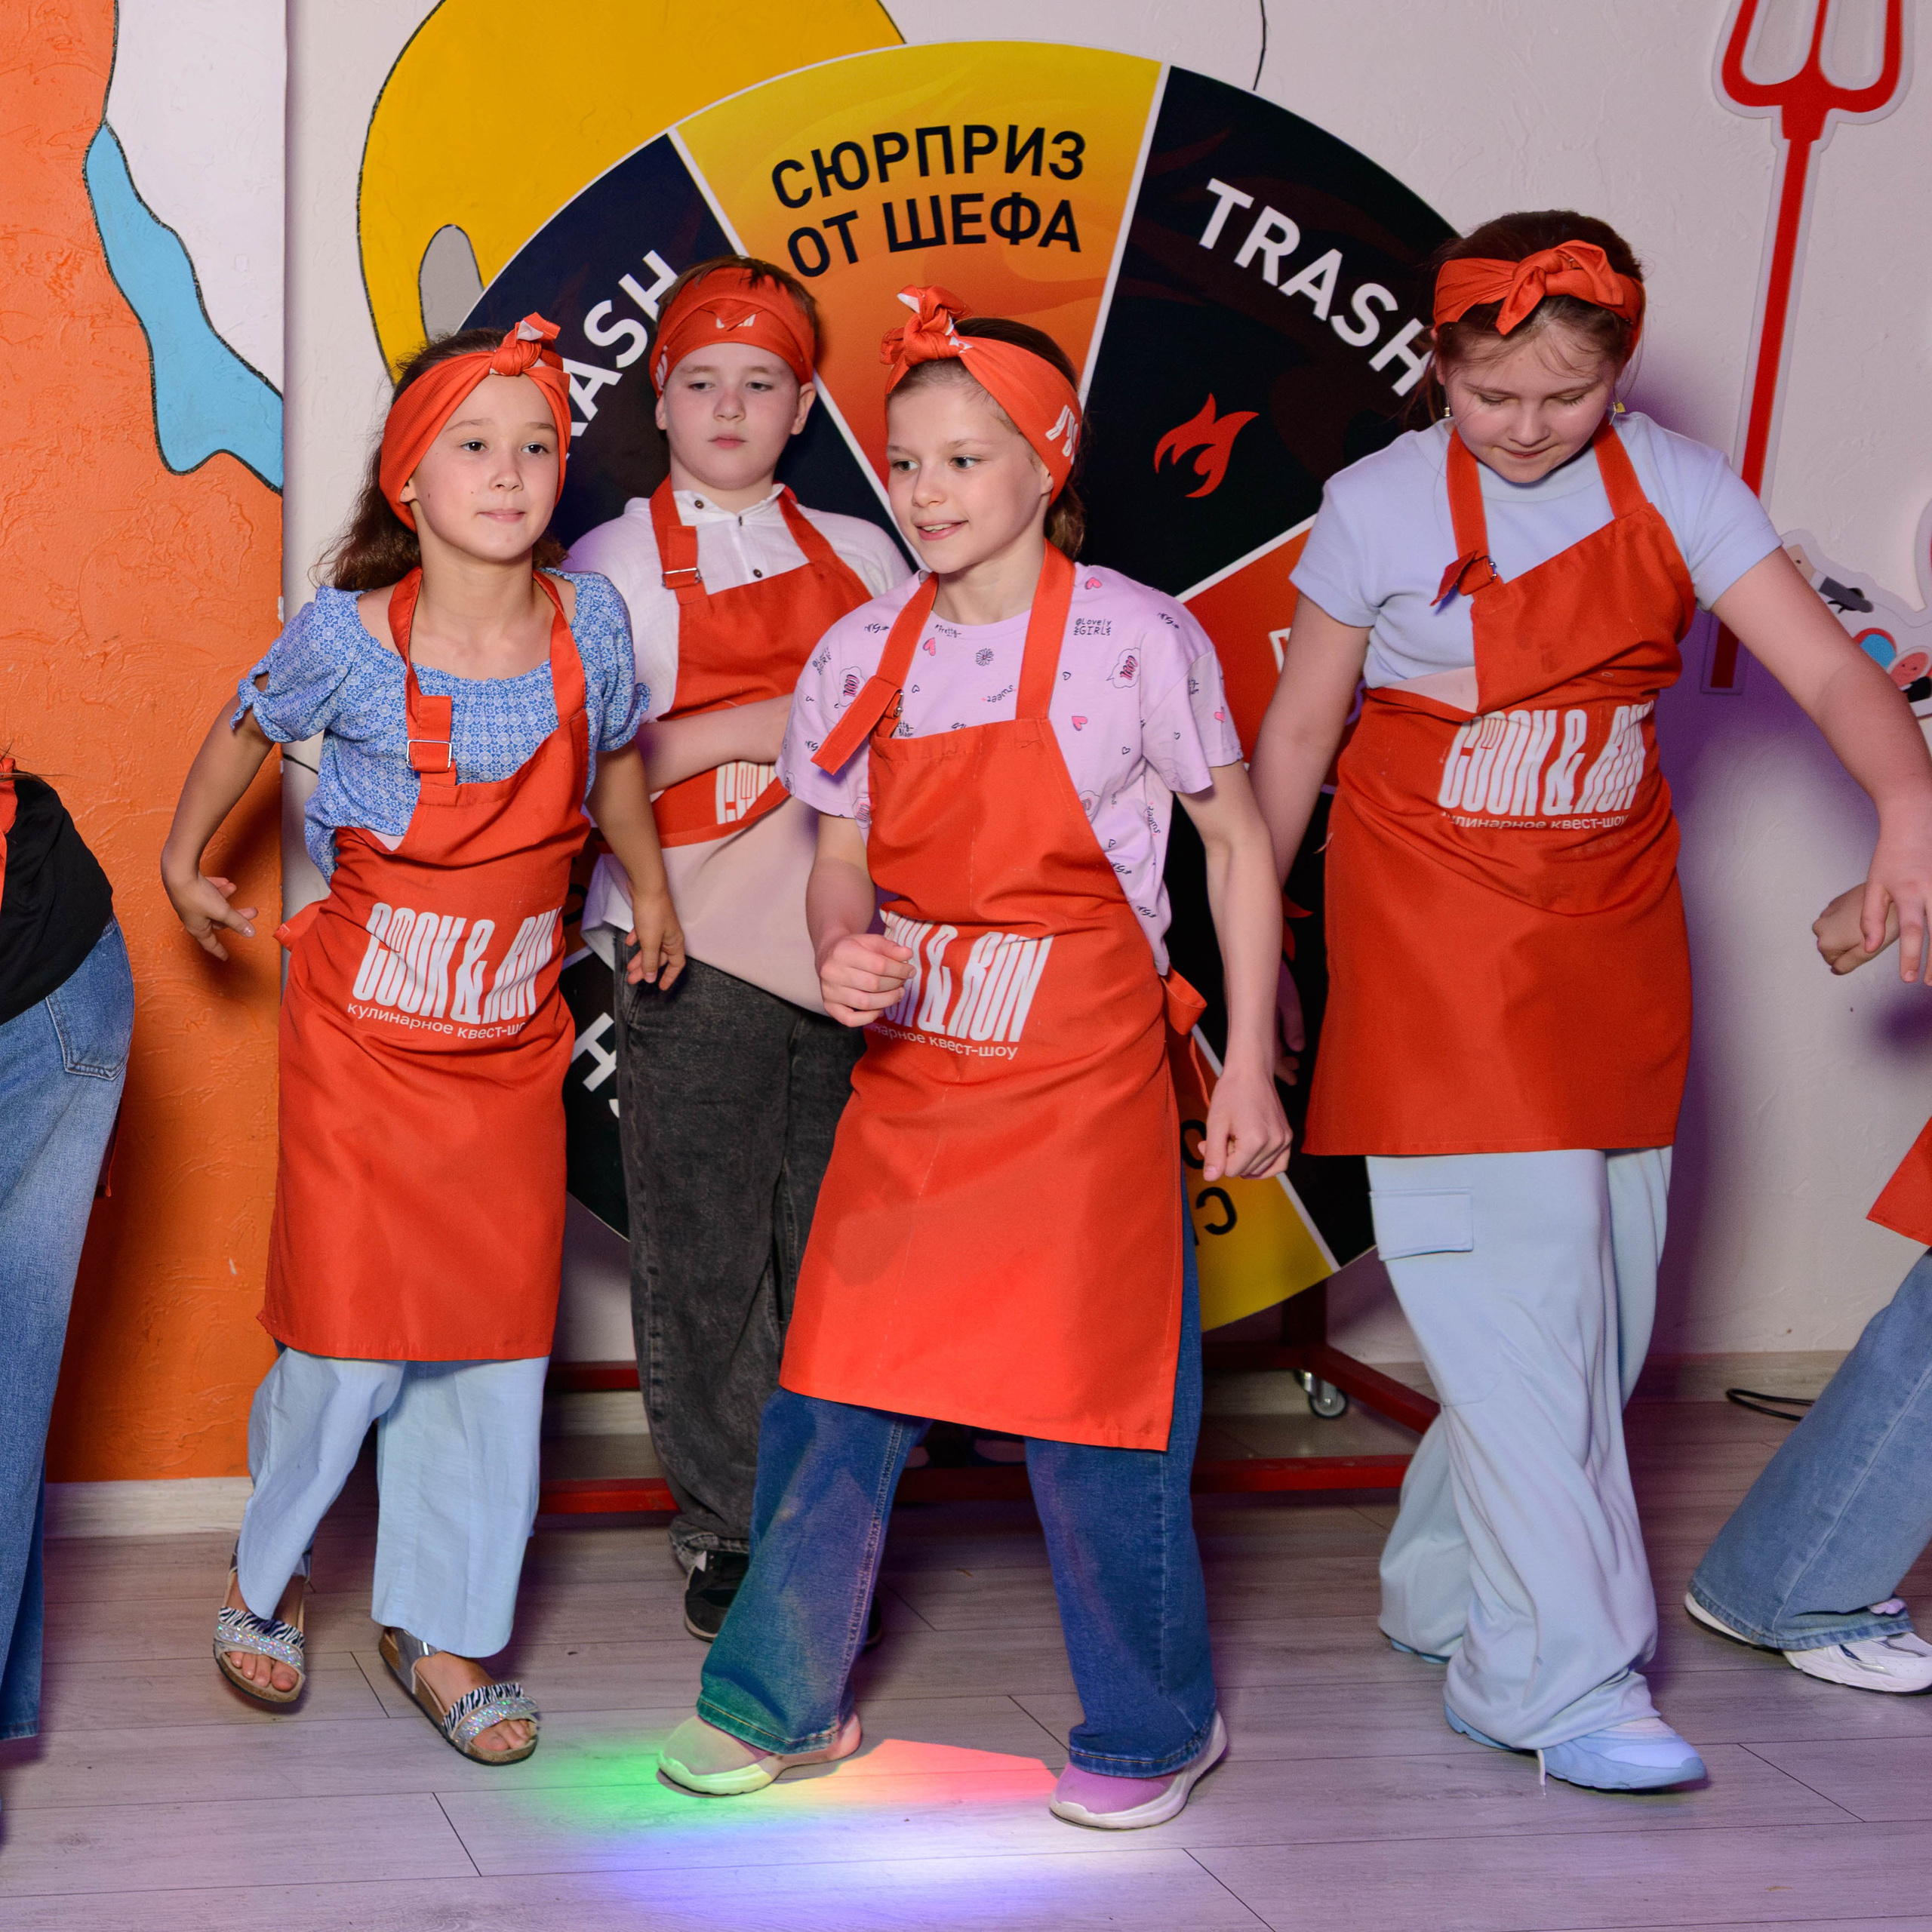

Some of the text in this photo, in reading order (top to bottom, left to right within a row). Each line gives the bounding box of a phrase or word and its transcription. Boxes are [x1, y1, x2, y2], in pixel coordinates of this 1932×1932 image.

[771, 124, 1086, 209] СЮРПРИЗ
[787, 191, 1081, 278] ОТ ШЕФА
[1198, 177, 1435, 398] TRASH
[561, 249, 679, 438] ASH
[352, 902, 467, 1019] COOK
[449, 918, 496, 1025] &
[946, 931, 1055, 1043] RUN
[347, 1002, 454, 1035] кулинарное
[929, 1036, 1019, 1060] квест-шоу
